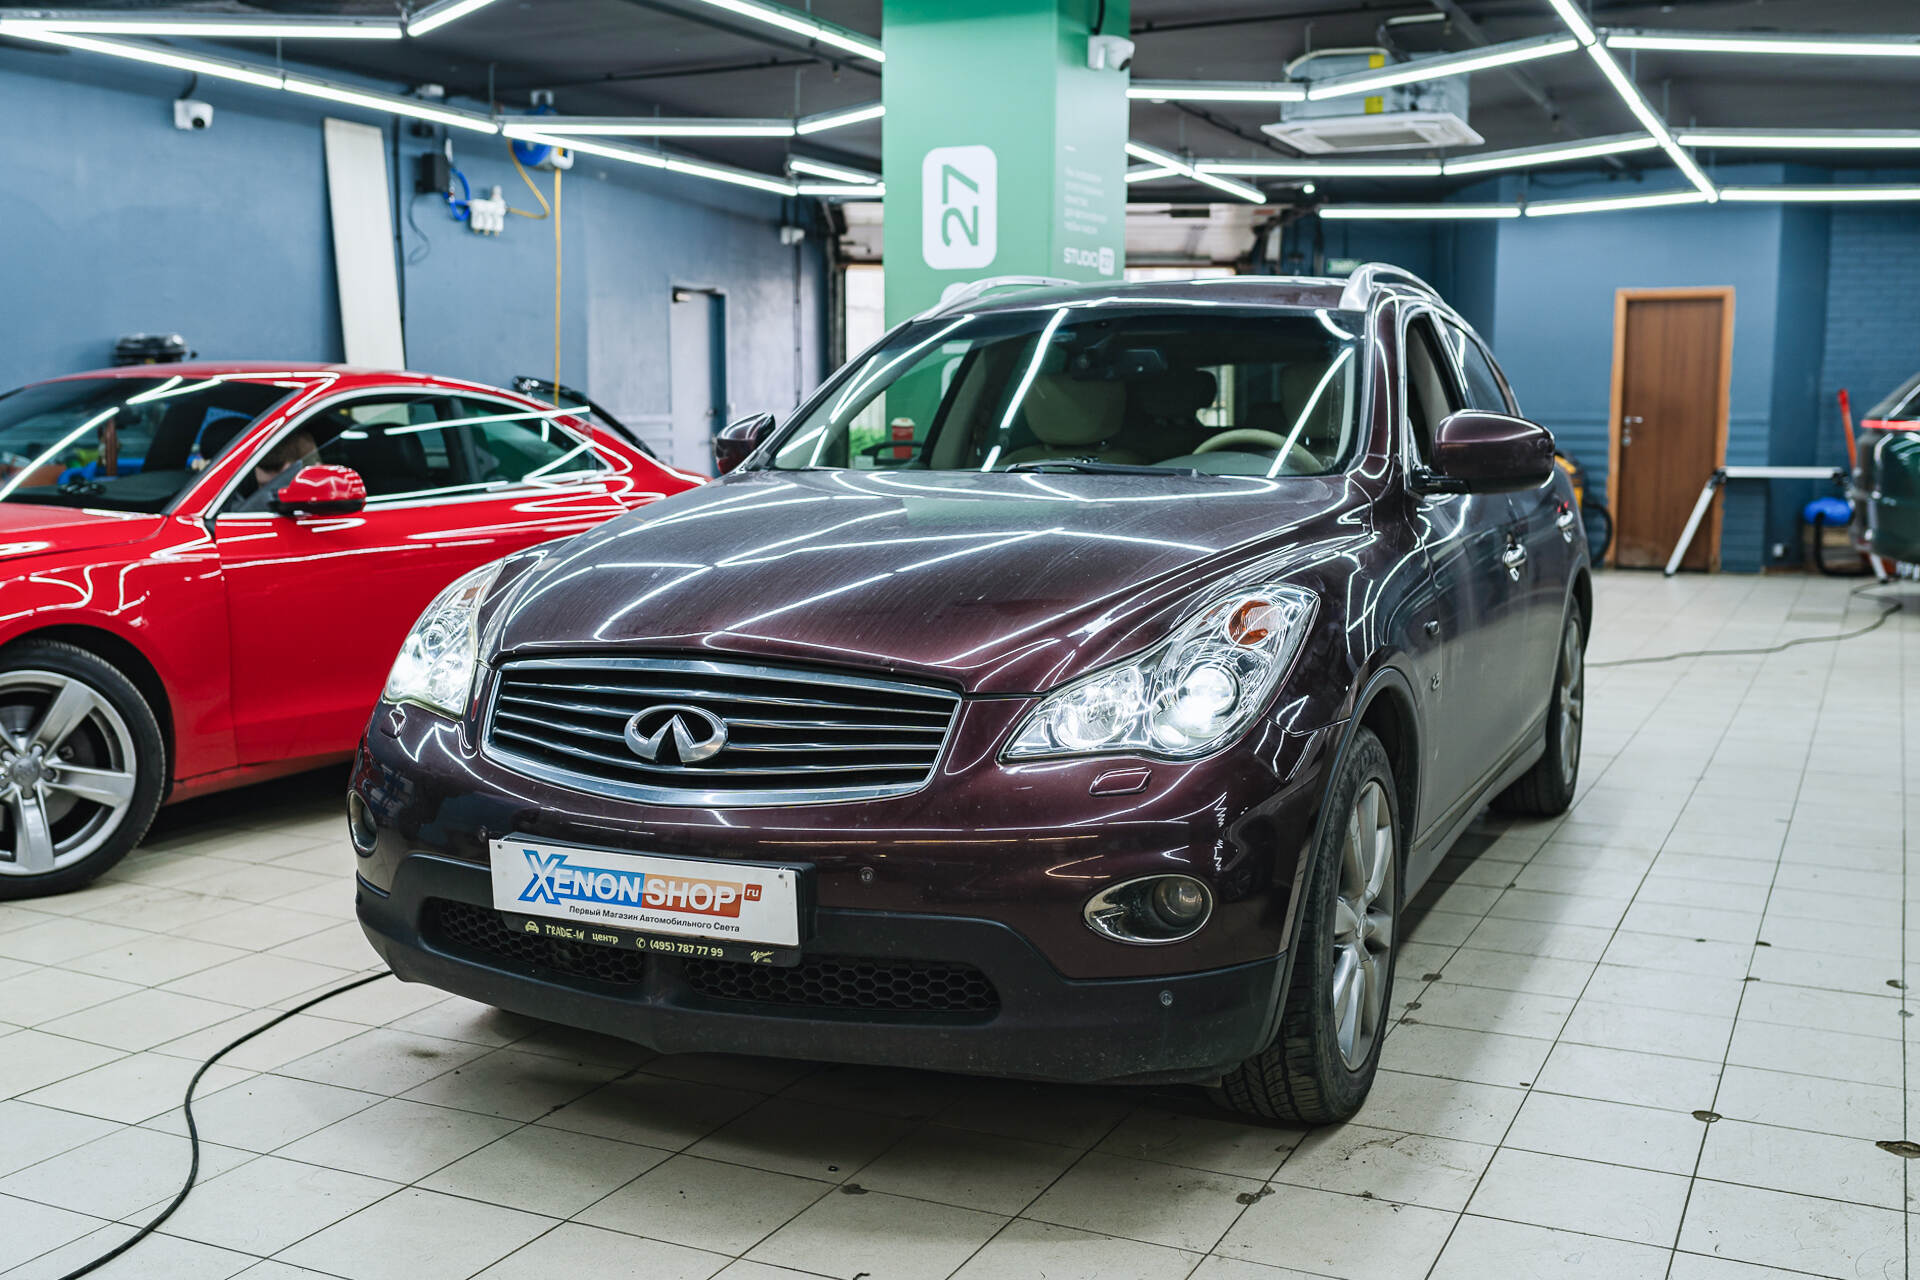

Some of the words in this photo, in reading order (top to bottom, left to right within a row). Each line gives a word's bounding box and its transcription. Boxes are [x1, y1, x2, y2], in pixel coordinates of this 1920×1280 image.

[942, 164, 979, 247] 27
[569, 905, 601, 917] Первый
[602, 910, 638, 921] Магазин
[639, 914, 712, 930] Автомобильного
[713, 922, 741, 933] Света
[545, 924, 585, 941] TRADE-IN
[592, 932, 619, 945] центр
[649, 939, 675, 952] (495)
[677, 943, 696, 955] 787
[697, 945, 710, 956] 77
[711, 947, 724, 957] 99
